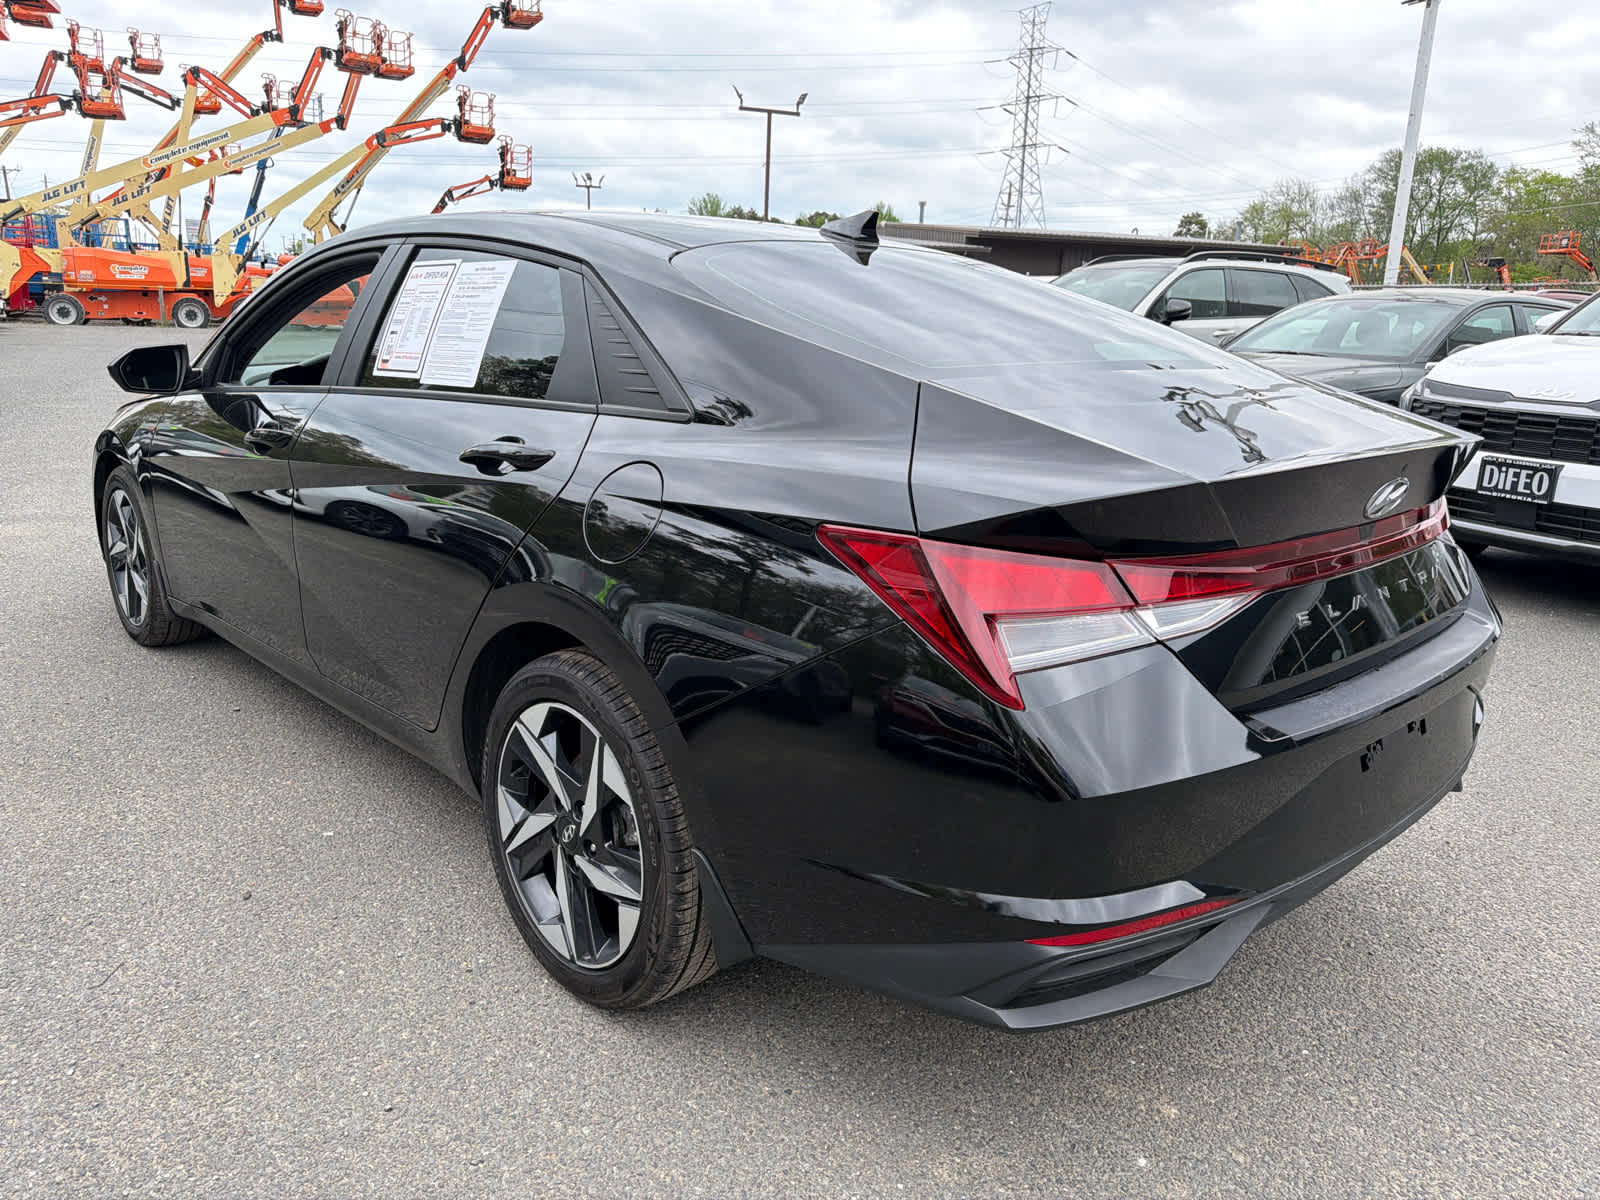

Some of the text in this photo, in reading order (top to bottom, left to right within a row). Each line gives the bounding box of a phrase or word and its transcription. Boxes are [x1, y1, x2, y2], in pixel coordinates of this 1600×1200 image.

[189, 132, 230, 151] equipment
[42, 189, 60, 202] JLG
[63, 180, 86, 194] LIFT
[112, 185, 151, 207] JLG LIFT
[161, 195, 175, 235] JLG LIFT
[232, 209, 267, 239] JLG LIFT
[1482, 464, 1549, 496] DiFEO
